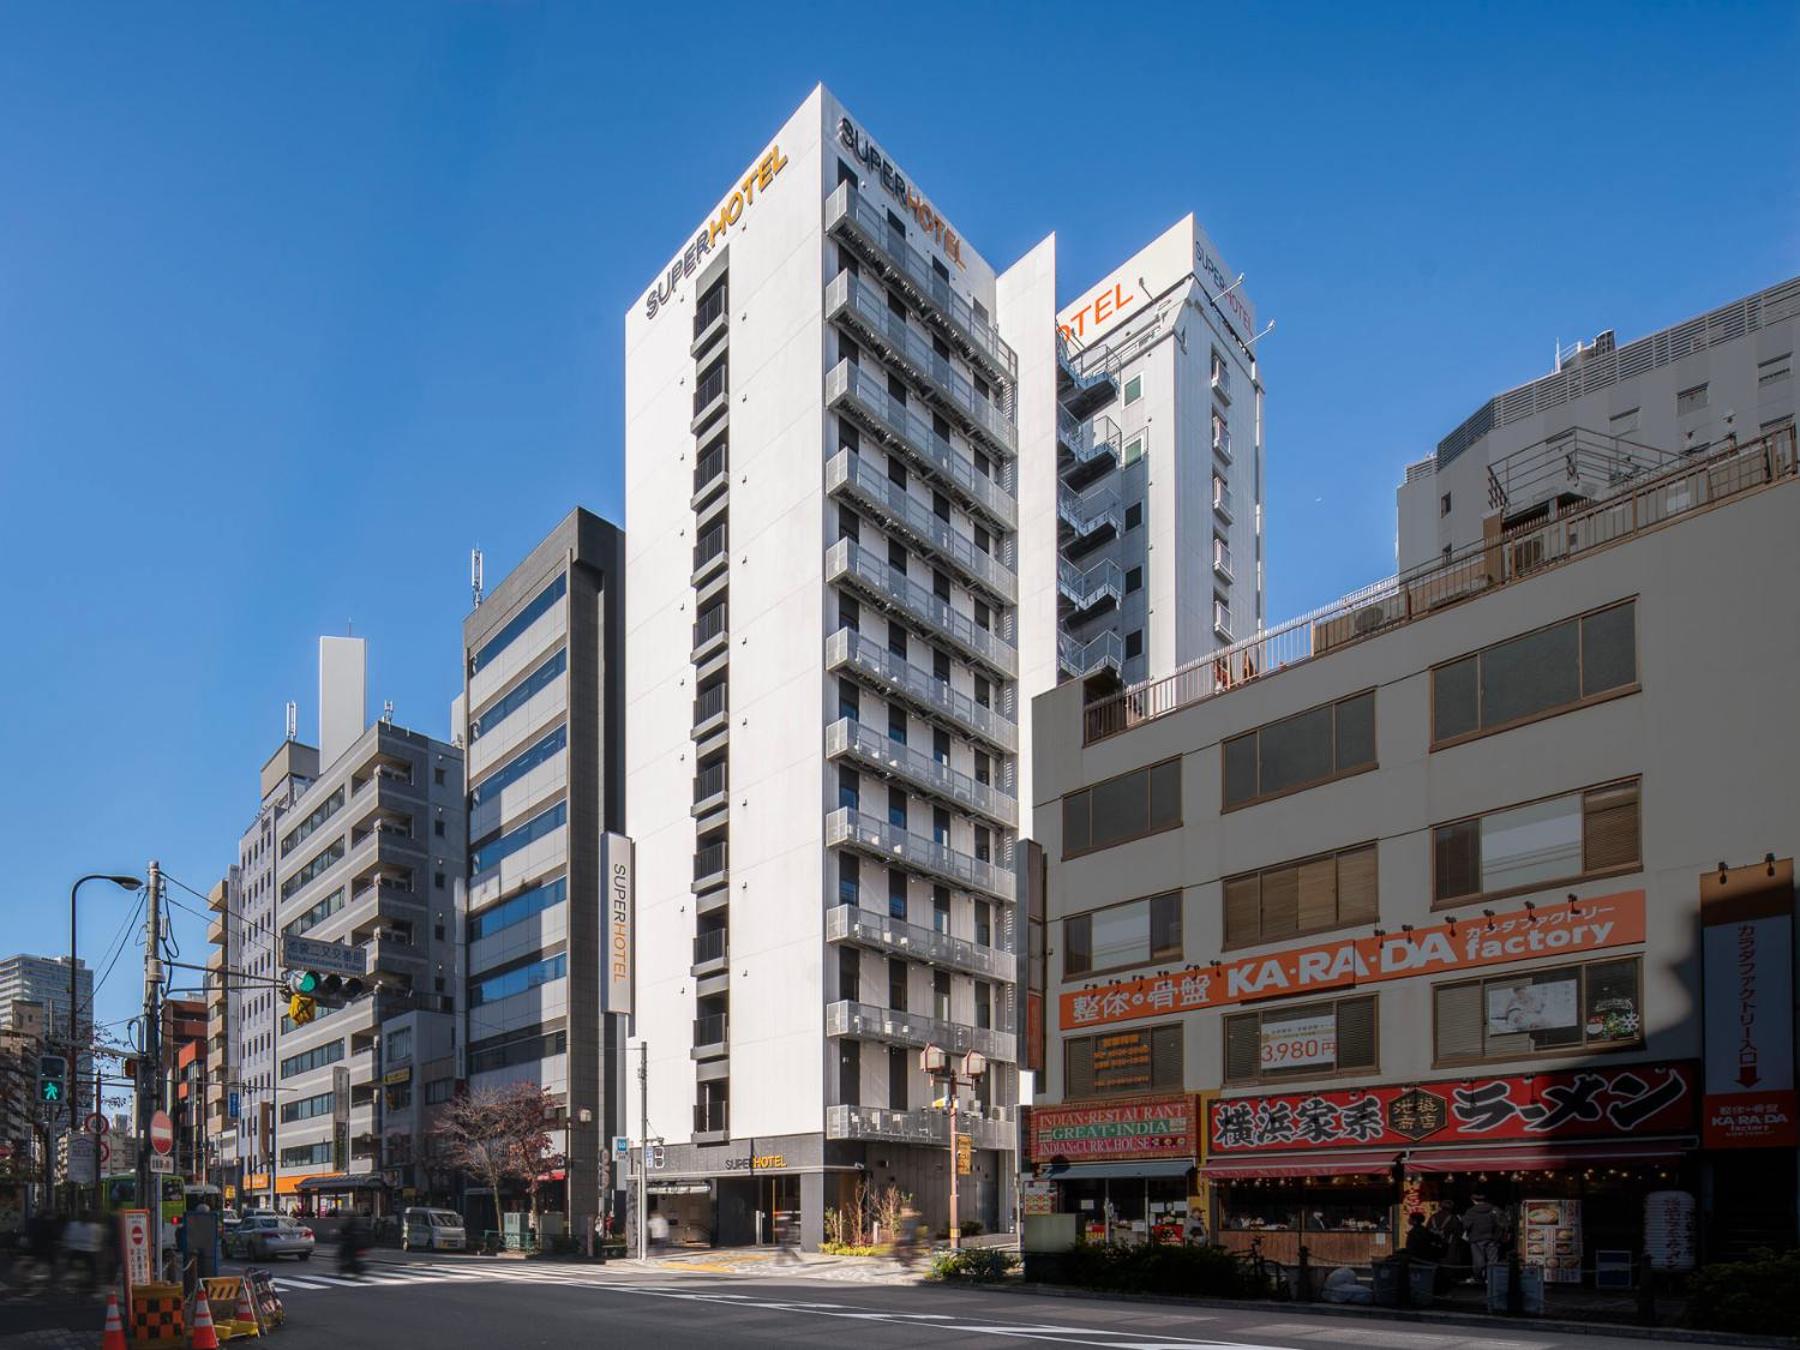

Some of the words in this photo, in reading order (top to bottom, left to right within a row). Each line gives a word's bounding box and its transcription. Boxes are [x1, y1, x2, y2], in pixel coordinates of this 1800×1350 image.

[1465, 921, 1615, 961] factory
[1452, 1068, 1687, 1133] ラーメン
[1213, 1095, 1386, 1147] 横浜家系
[725, 1154, 788, 1170] SUPEHOTEL
[1114, 1136, 1151, 1152] HOUSE
